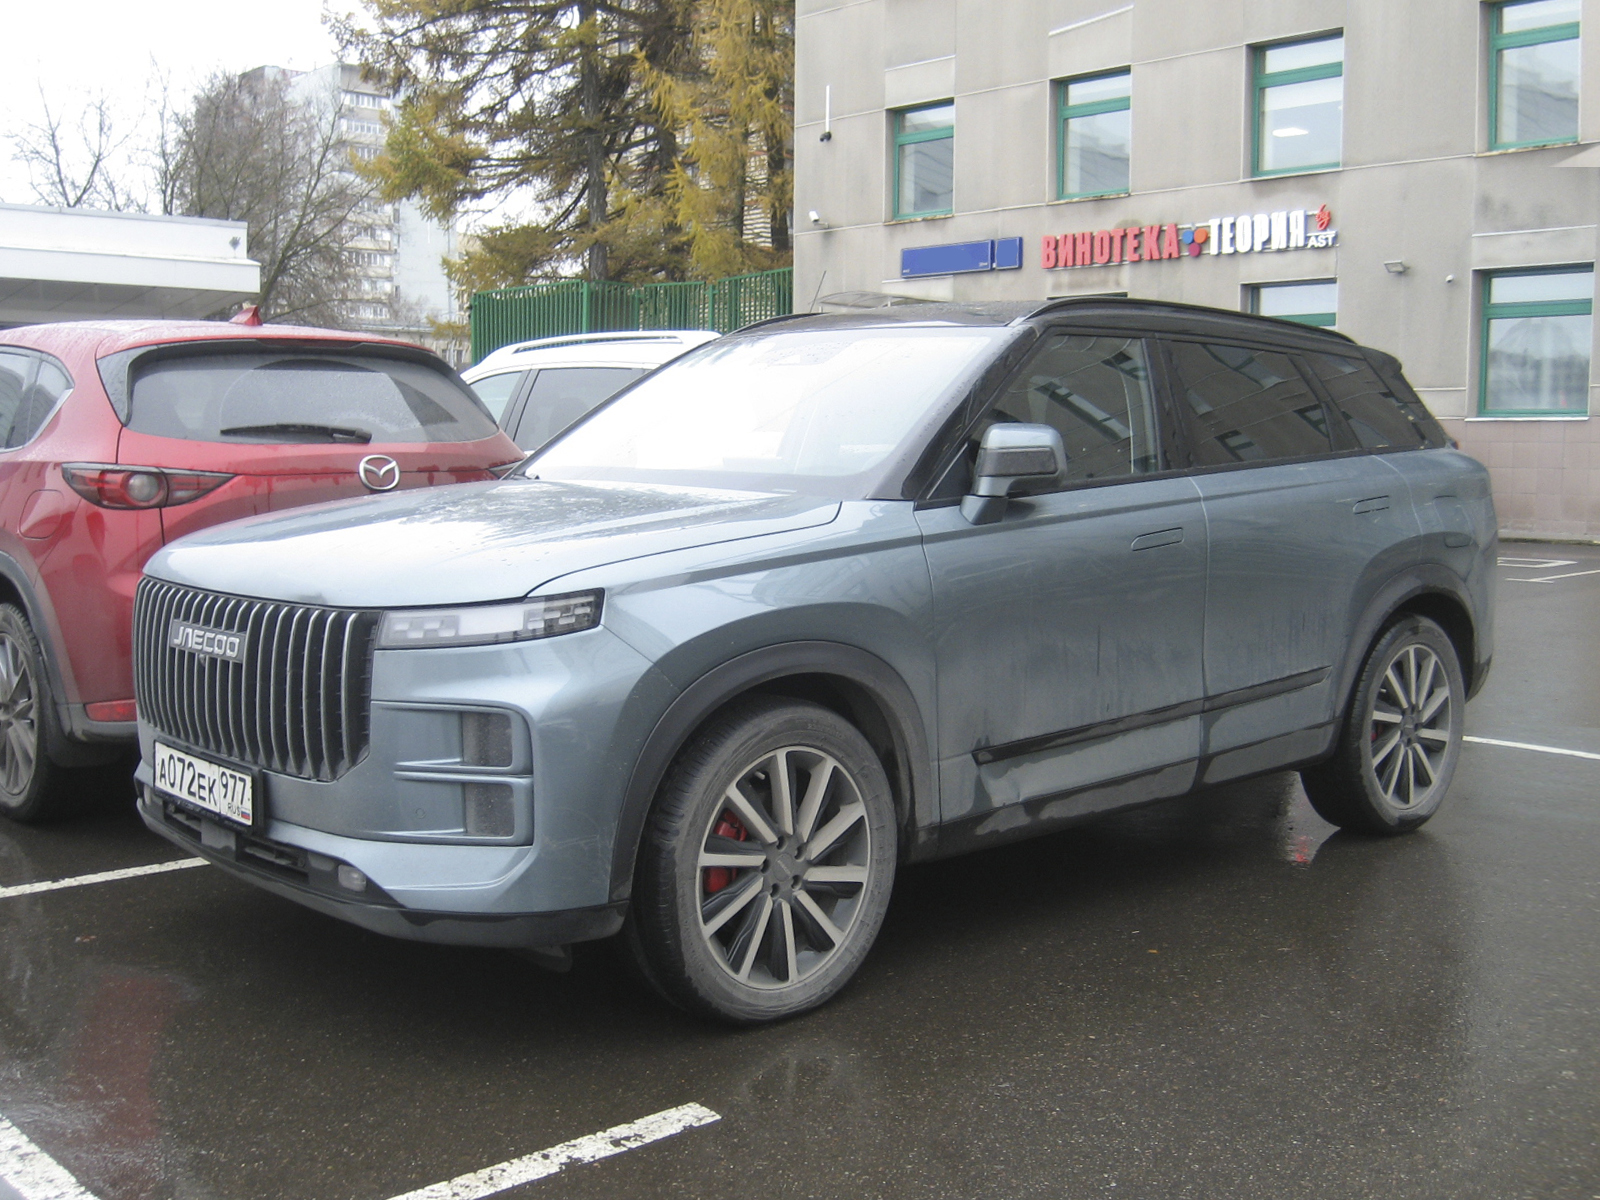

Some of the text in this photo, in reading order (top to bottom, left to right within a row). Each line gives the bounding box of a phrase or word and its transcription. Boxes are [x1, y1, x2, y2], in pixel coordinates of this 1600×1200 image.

[1040, 209, 1307, 269] ВИНОТЕКА ТЕОРИЯ
[1307, 233, 1336, 249] AST
[173, 626, 240, 658] JAECOO
[220, 770, 247, 805] 977
[227, 802, 241, 817] RUS
